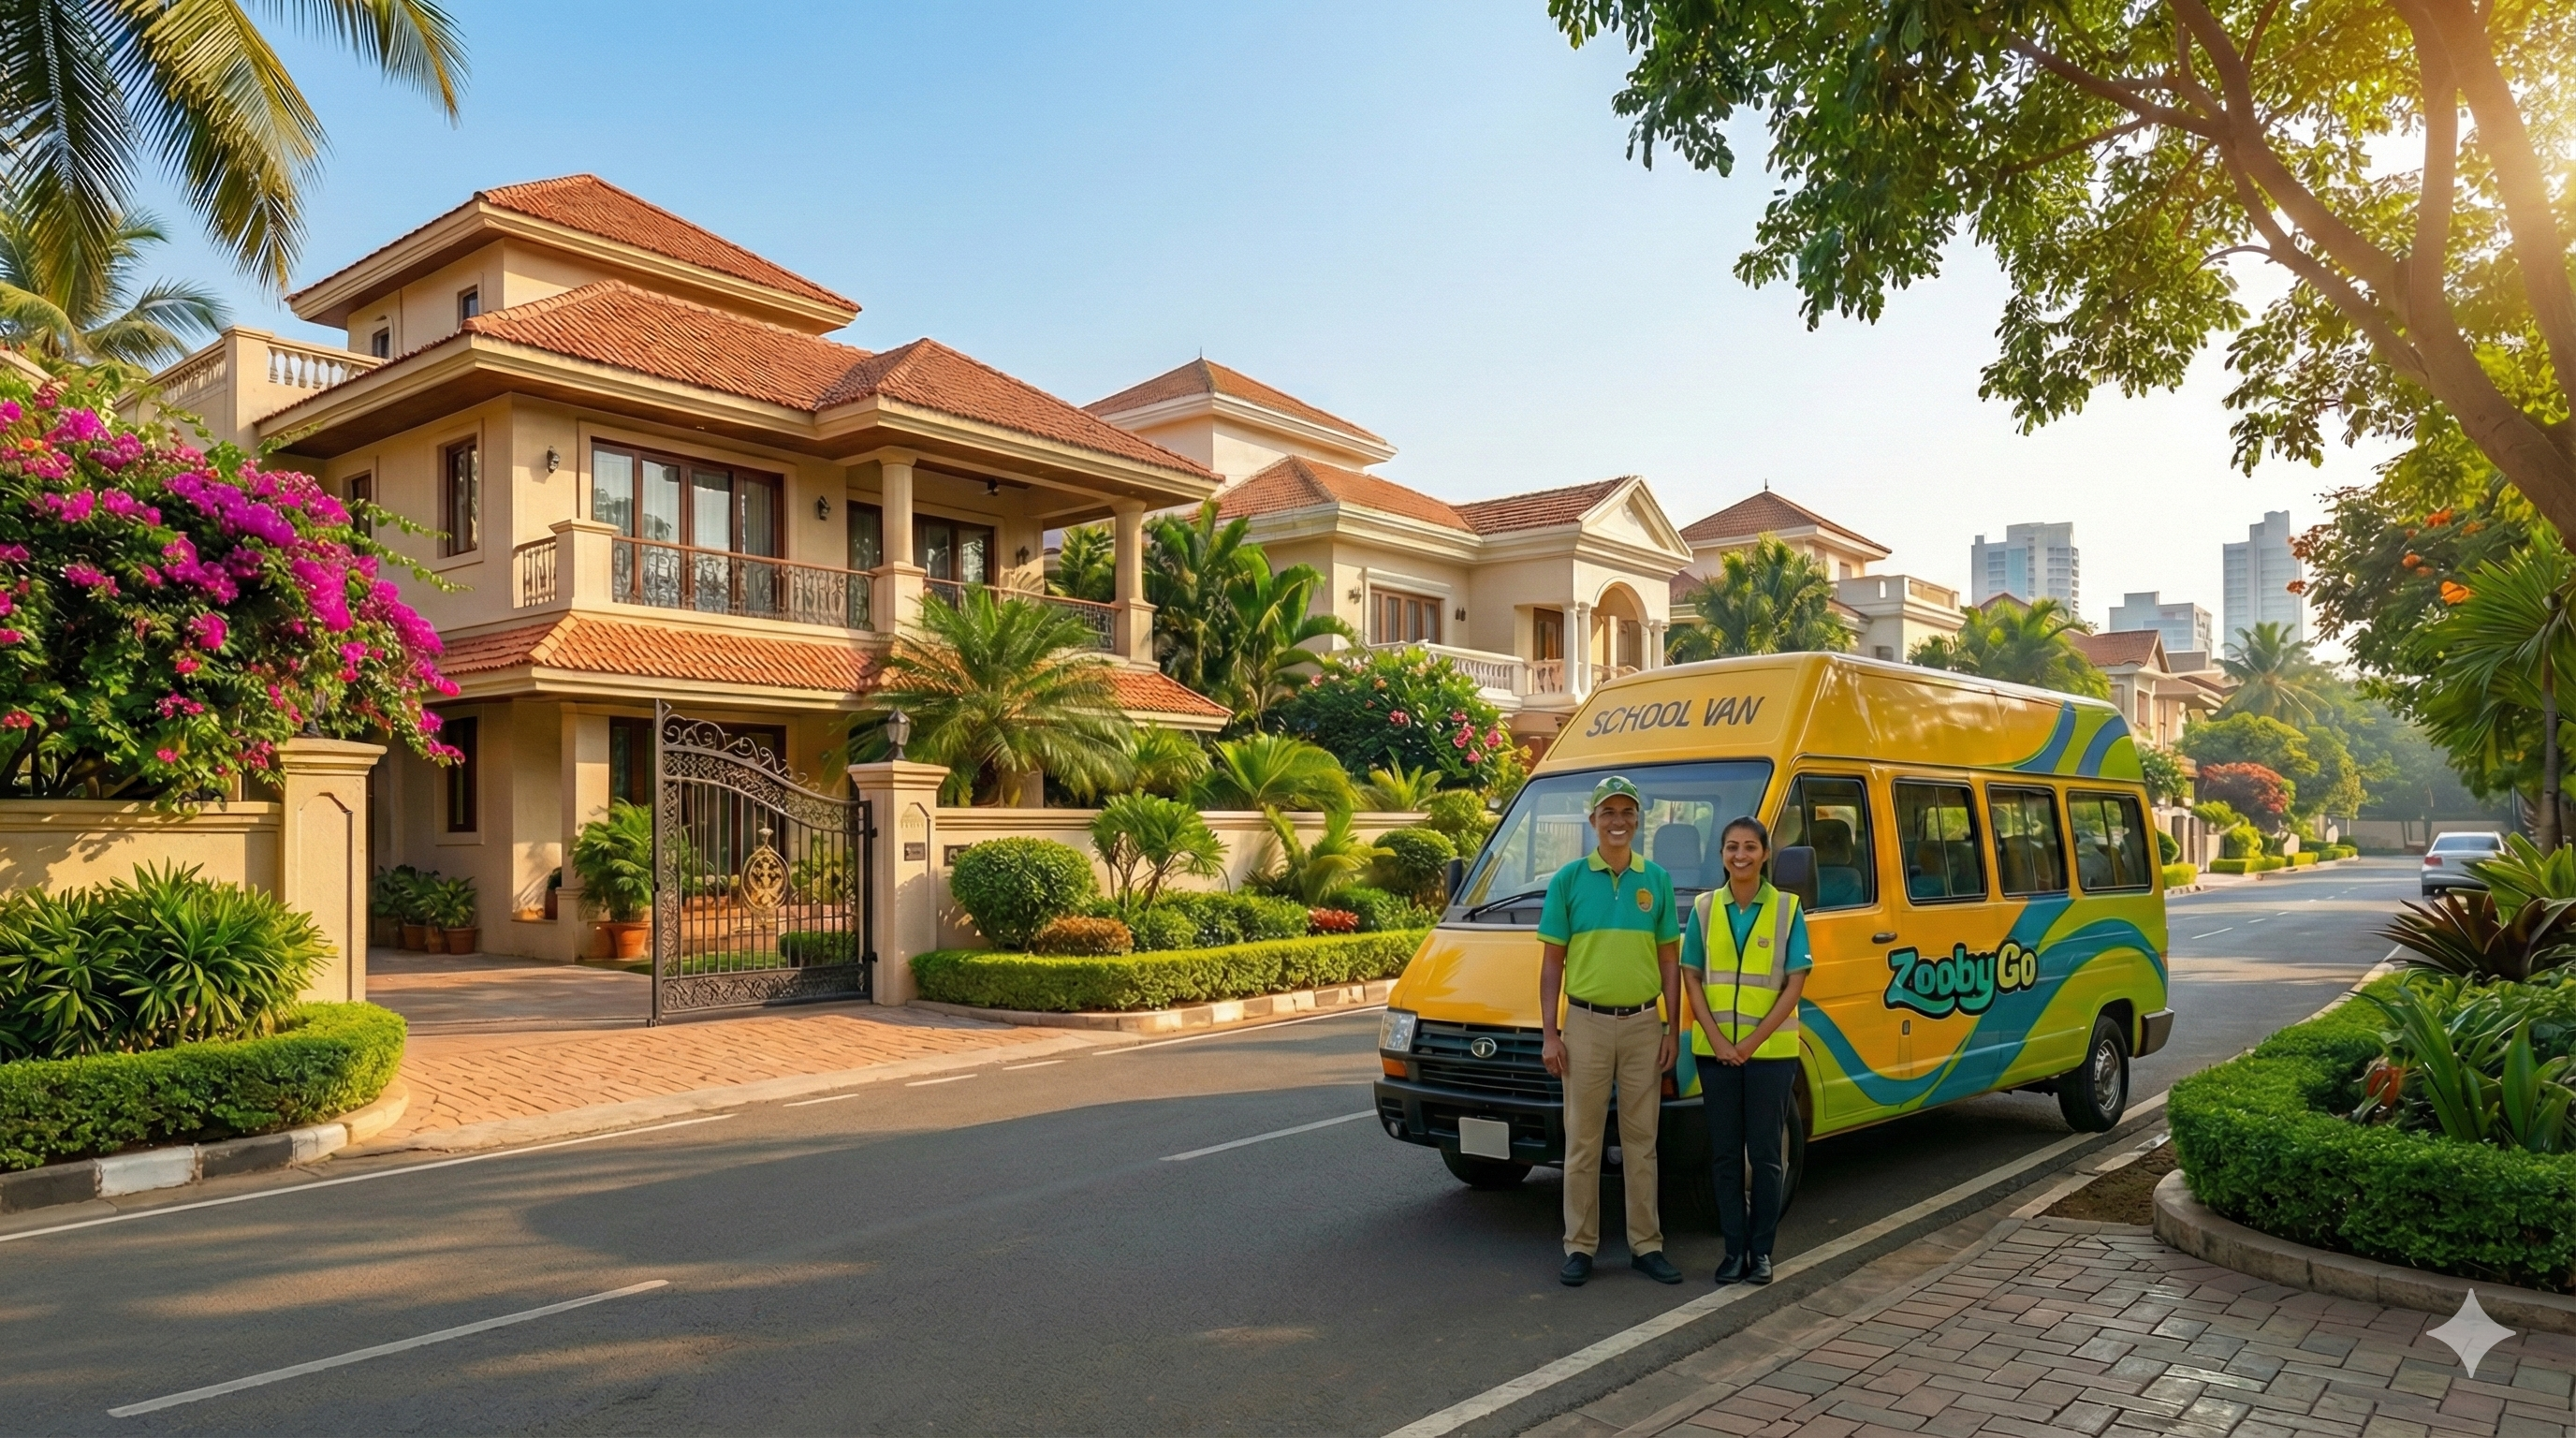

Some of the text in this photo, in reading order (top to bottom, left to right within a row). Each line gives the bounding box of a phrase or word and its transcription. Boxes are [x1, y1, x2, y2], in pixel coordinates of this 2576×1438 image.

[1586, 695, 1766, 738] SCHOOL VAN
[1885, 941, 2038, 1016] ZoobyGo
